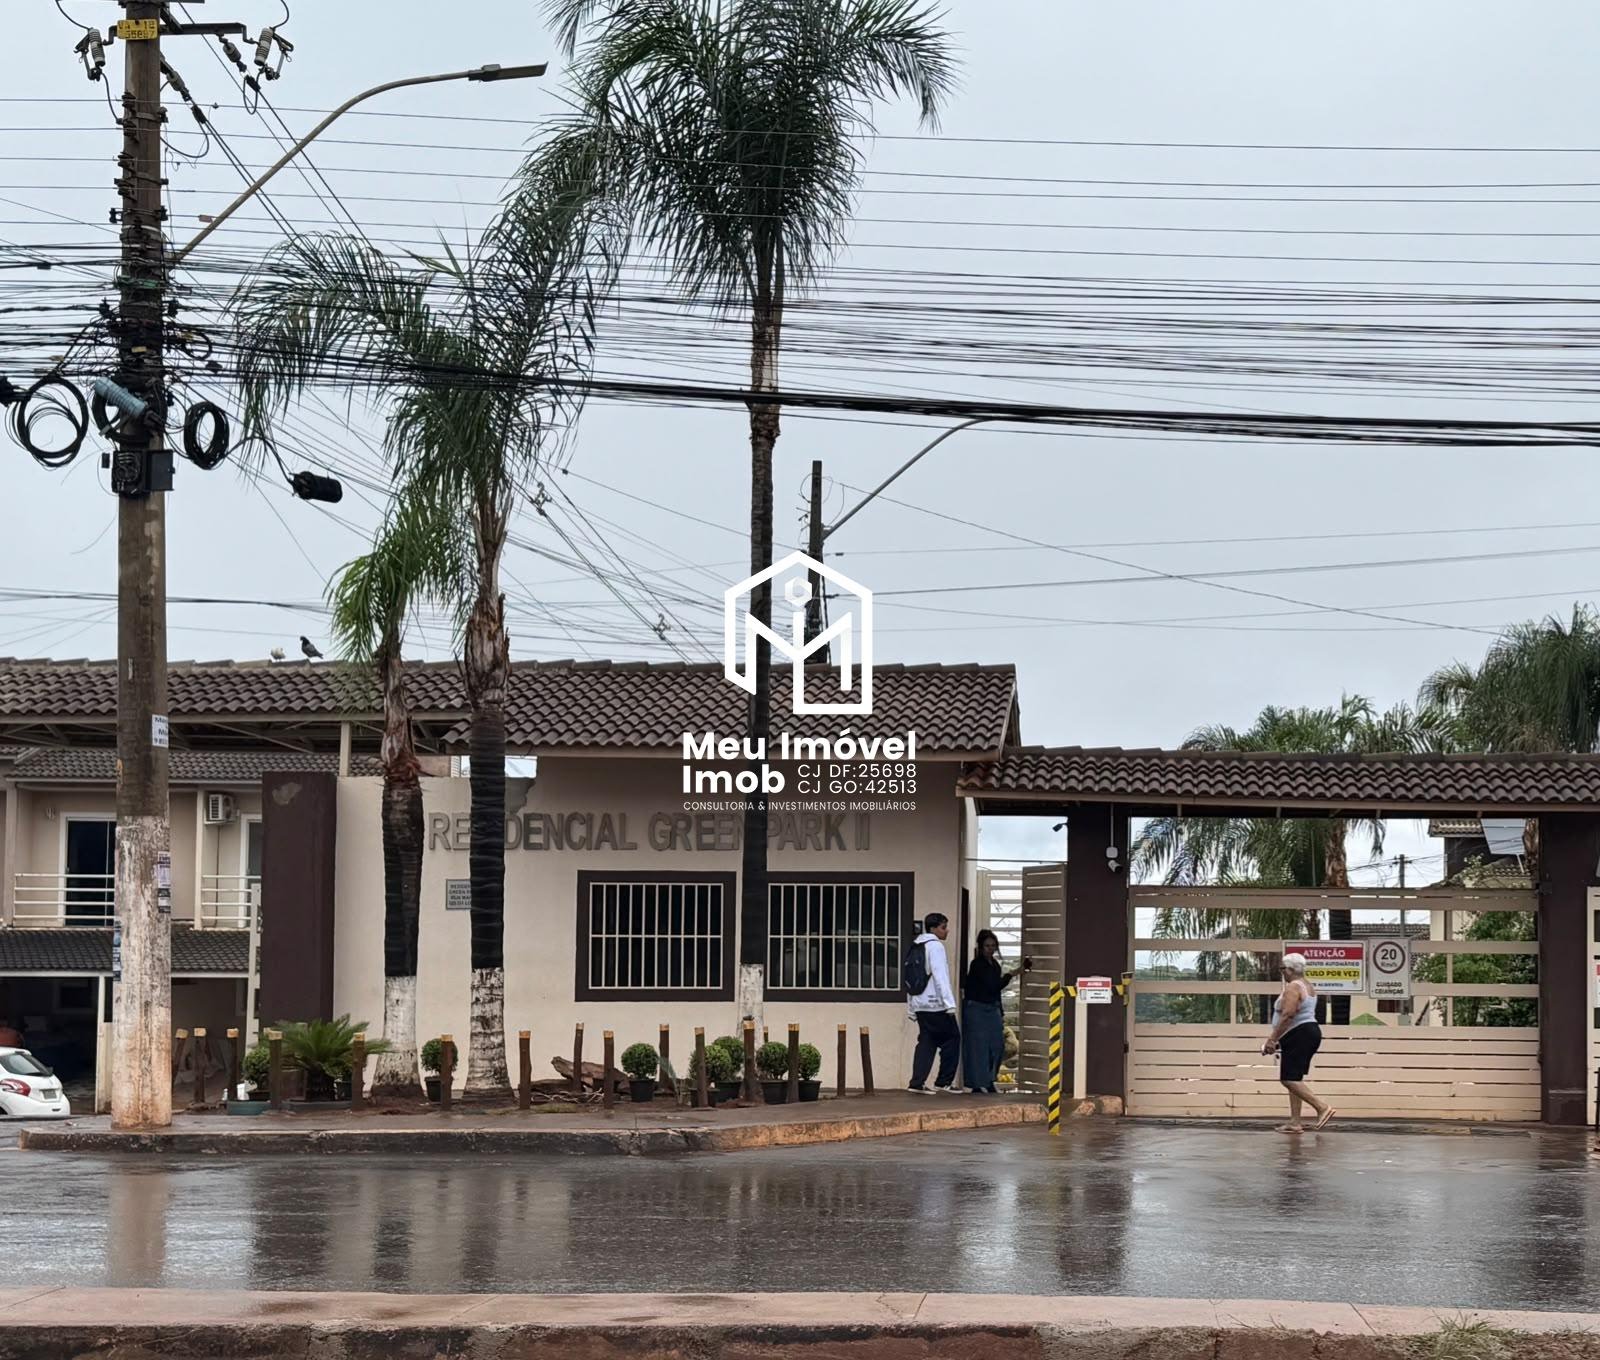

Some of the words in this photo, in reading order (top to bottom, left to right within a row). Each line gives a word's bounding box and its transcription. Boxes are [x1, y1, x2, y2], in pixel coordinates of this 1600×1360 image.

[428, 812, 638, 851] REDENCIAL
[766, 812, 848, 851] PARK
[1303, 948, 1346, 958] ATENÇÃO
[1381, 948, 1397, 960] 20
